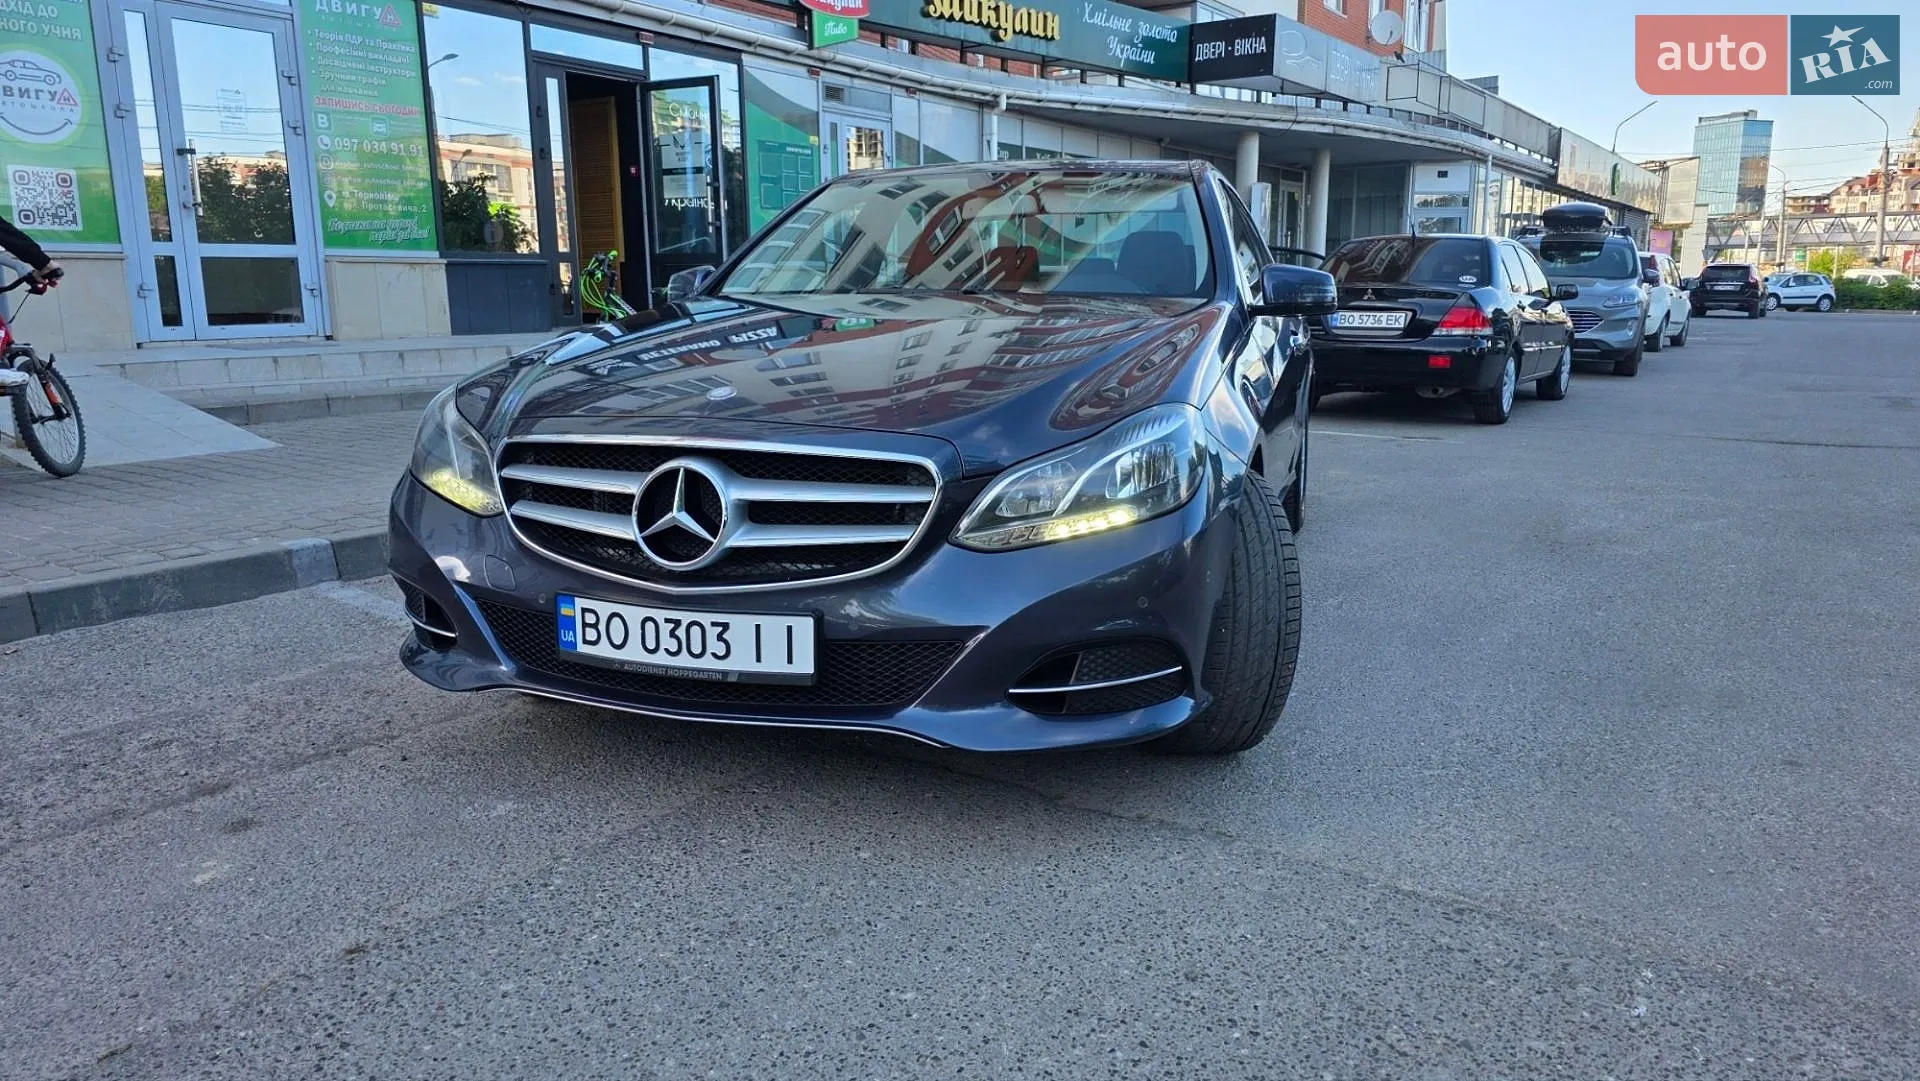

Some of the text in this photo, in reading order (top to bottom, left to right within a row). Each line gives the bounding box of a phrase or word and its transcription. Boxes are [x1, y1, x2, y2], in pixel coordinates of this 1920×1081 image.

[38, 4, 58, 18] ДО
[1082, 1, 1132, 33] Хмільне
[41, 23, 82, 40] УЧНЯ
[824, 20, 847, 36] Пиво
[1107, 35, 1156, 67] України
[1195, 36, 1266, 62] ДВЕРІ ВІКНА
[334, 137, 423, 157] 097 034 91 91
[1357, 314, 1384, 326] 5736
[561, 629, 575, 643] UA
[581, 606, 630, 650] BO
[640, 615, 732, 661] 0303
[623, 663, 723, 681] AUTODIENST HOPPEGARTEN
